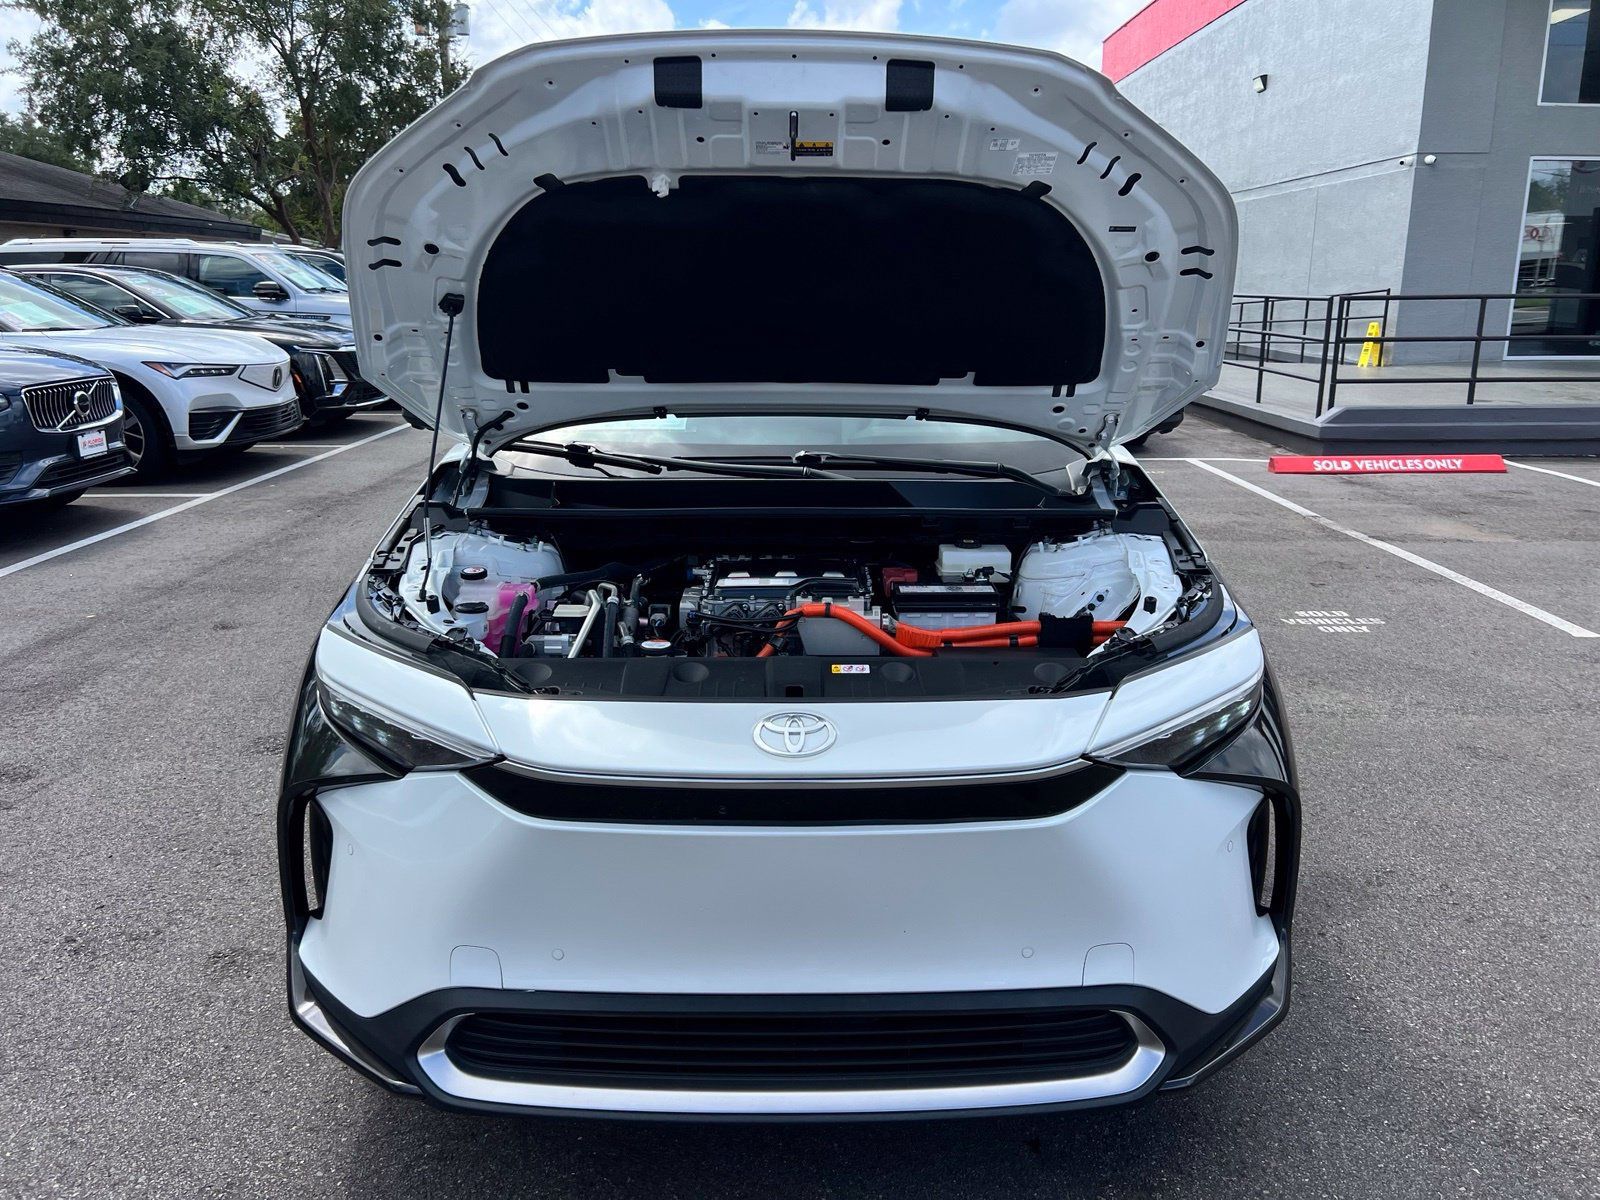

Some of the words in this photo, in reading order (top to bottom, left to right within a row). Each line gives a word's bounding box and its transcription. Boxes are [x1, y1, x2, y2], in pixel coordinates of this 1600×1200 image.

[1312, 460, 1351, 471] SOLD
[1355, 459, 1423, 471] VEHICLES
[1424, 458, 1463, 470] ONLY
[1280, 617, 1386, 625] VEHICLES
[1317, 625, 1371, 633] ONLY
